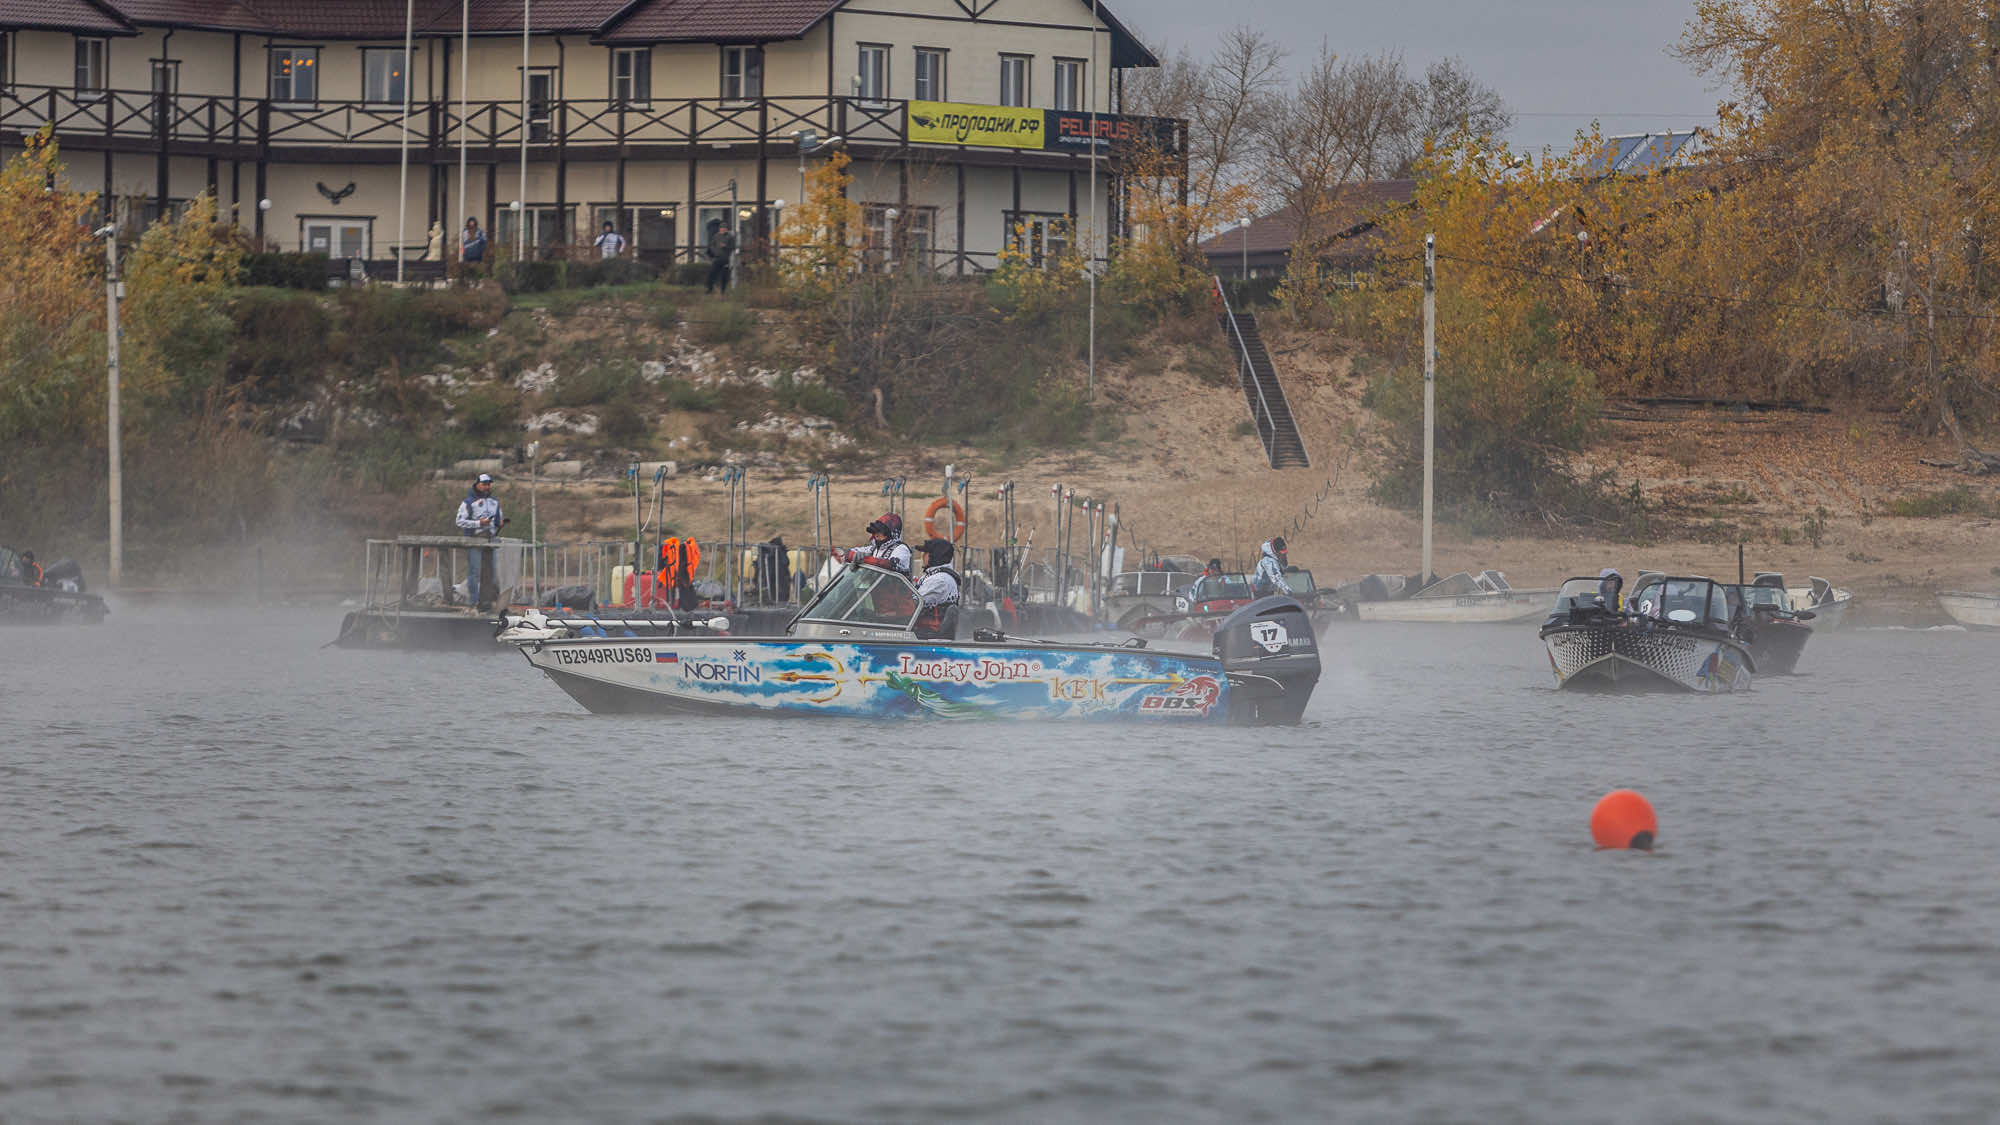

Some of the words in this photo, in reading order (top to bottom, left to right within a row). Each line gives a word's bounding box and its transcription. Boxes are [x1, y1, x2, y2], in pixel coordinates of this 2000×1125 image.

[940, 113, 1040, 142] ПРОЛОДКИ.РФ
[1058, 117, 1129, 139] PELORUS
[1260, 628, 1278, 641] 17
[552, 648, 652, 665] TB2949RUS69
[684, 661, 760, 682] NORFIN
[900, 656, 971, 682] Lucky
[1142, 695, 1203, 710] BBS
